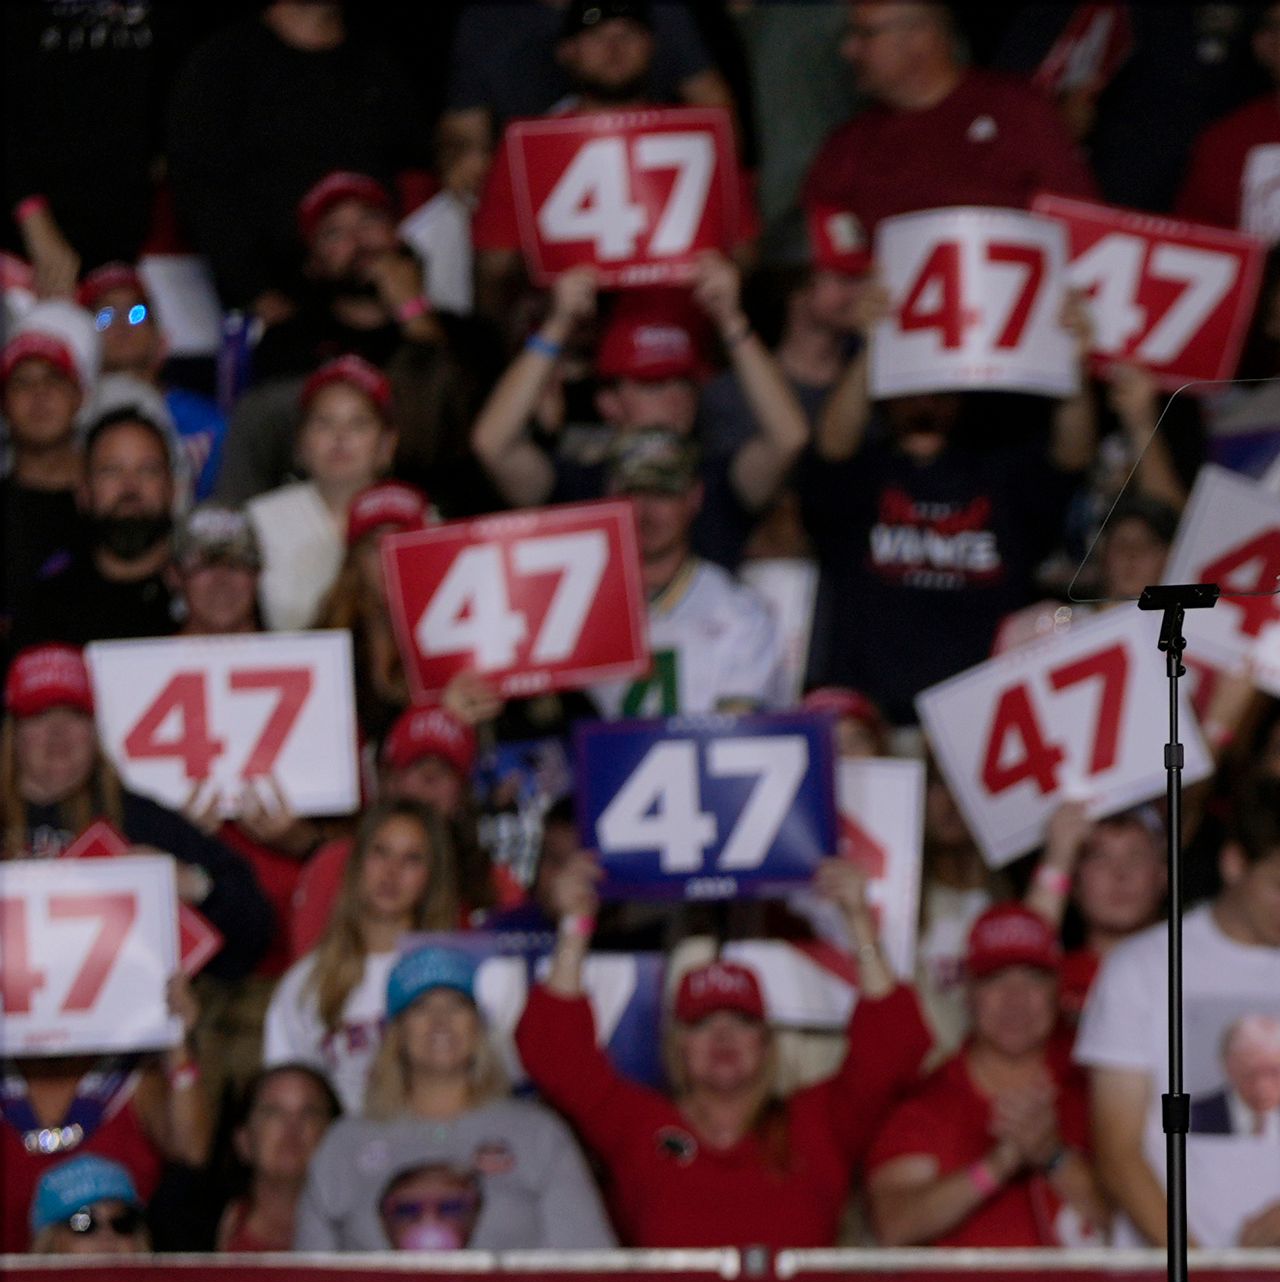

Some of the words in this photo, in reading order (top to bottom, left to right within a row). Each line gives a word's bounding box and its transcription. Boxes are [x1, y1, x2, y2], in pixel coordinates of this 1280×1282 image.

[537, 131, 716, 260] 47
[900, 240, 1049, 350] 47
[1068, 232, 1242, 365] 47
[417, 530, 609, 670] 47
[124, 667, 313, 781] 47
[978, 644, 1130, 795] 47
[596, 734, 809, 873] 47
